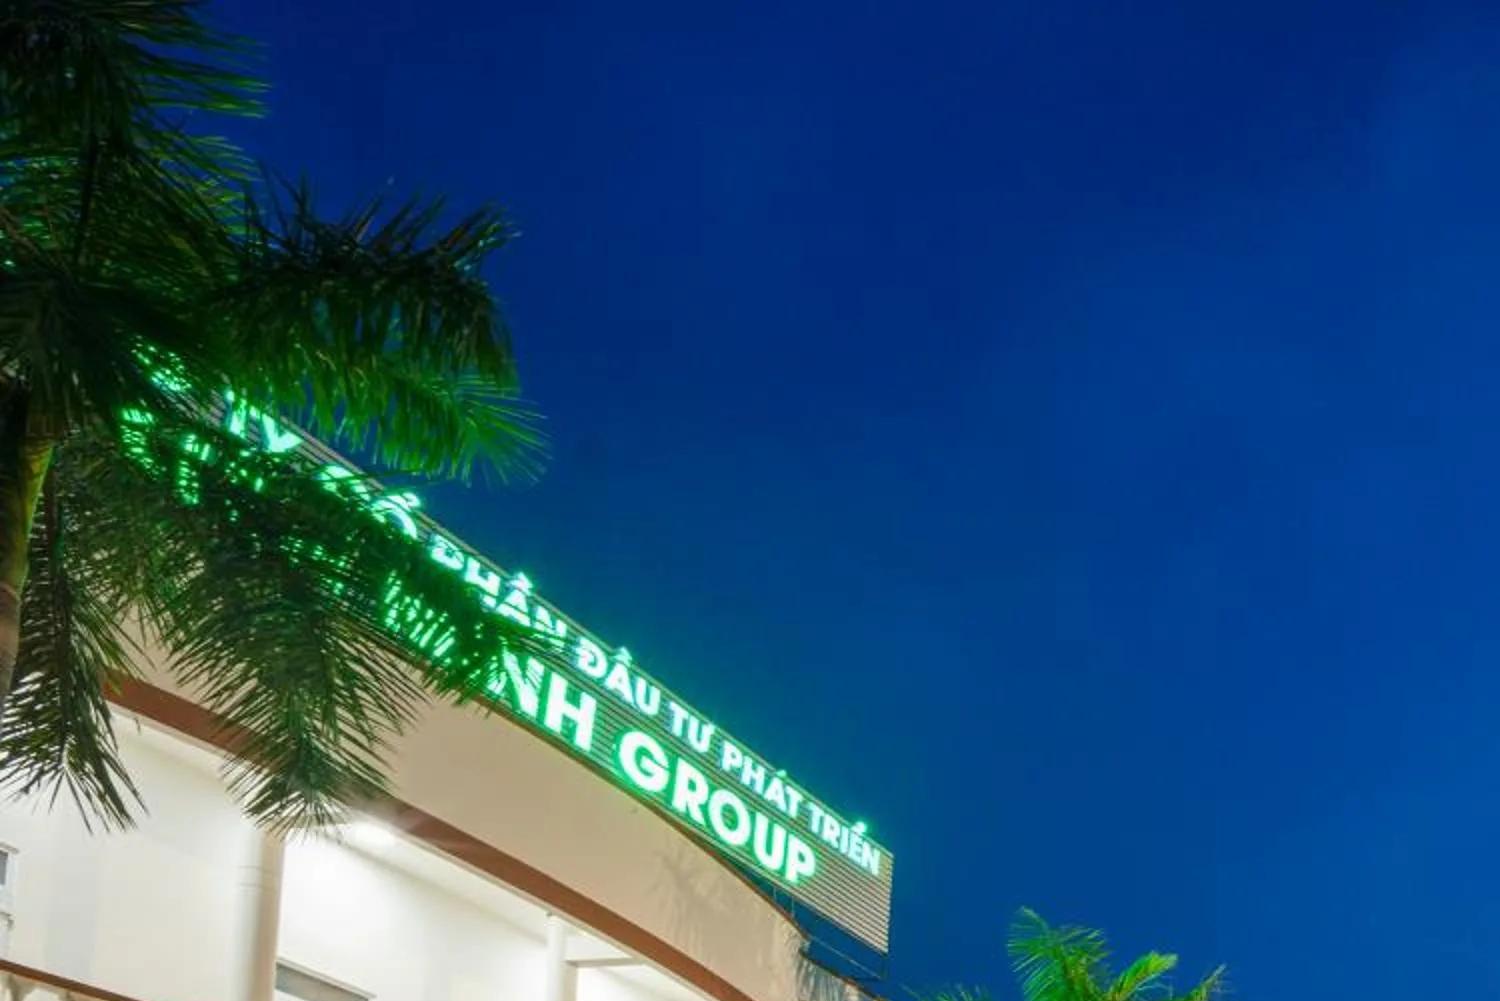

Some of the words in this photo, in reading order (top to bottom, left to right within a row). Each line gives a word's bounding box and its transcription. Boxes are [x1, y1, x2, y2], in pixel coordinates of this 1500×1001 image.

[572, 636, 661, 716] ĐẦU
[669, 701, 714, 753] TƯ
[721, 739, 803, 818] PHÁT
[807, 799, 881, 876] TRIỂN
[619, 731, 817, 884] GROUP
